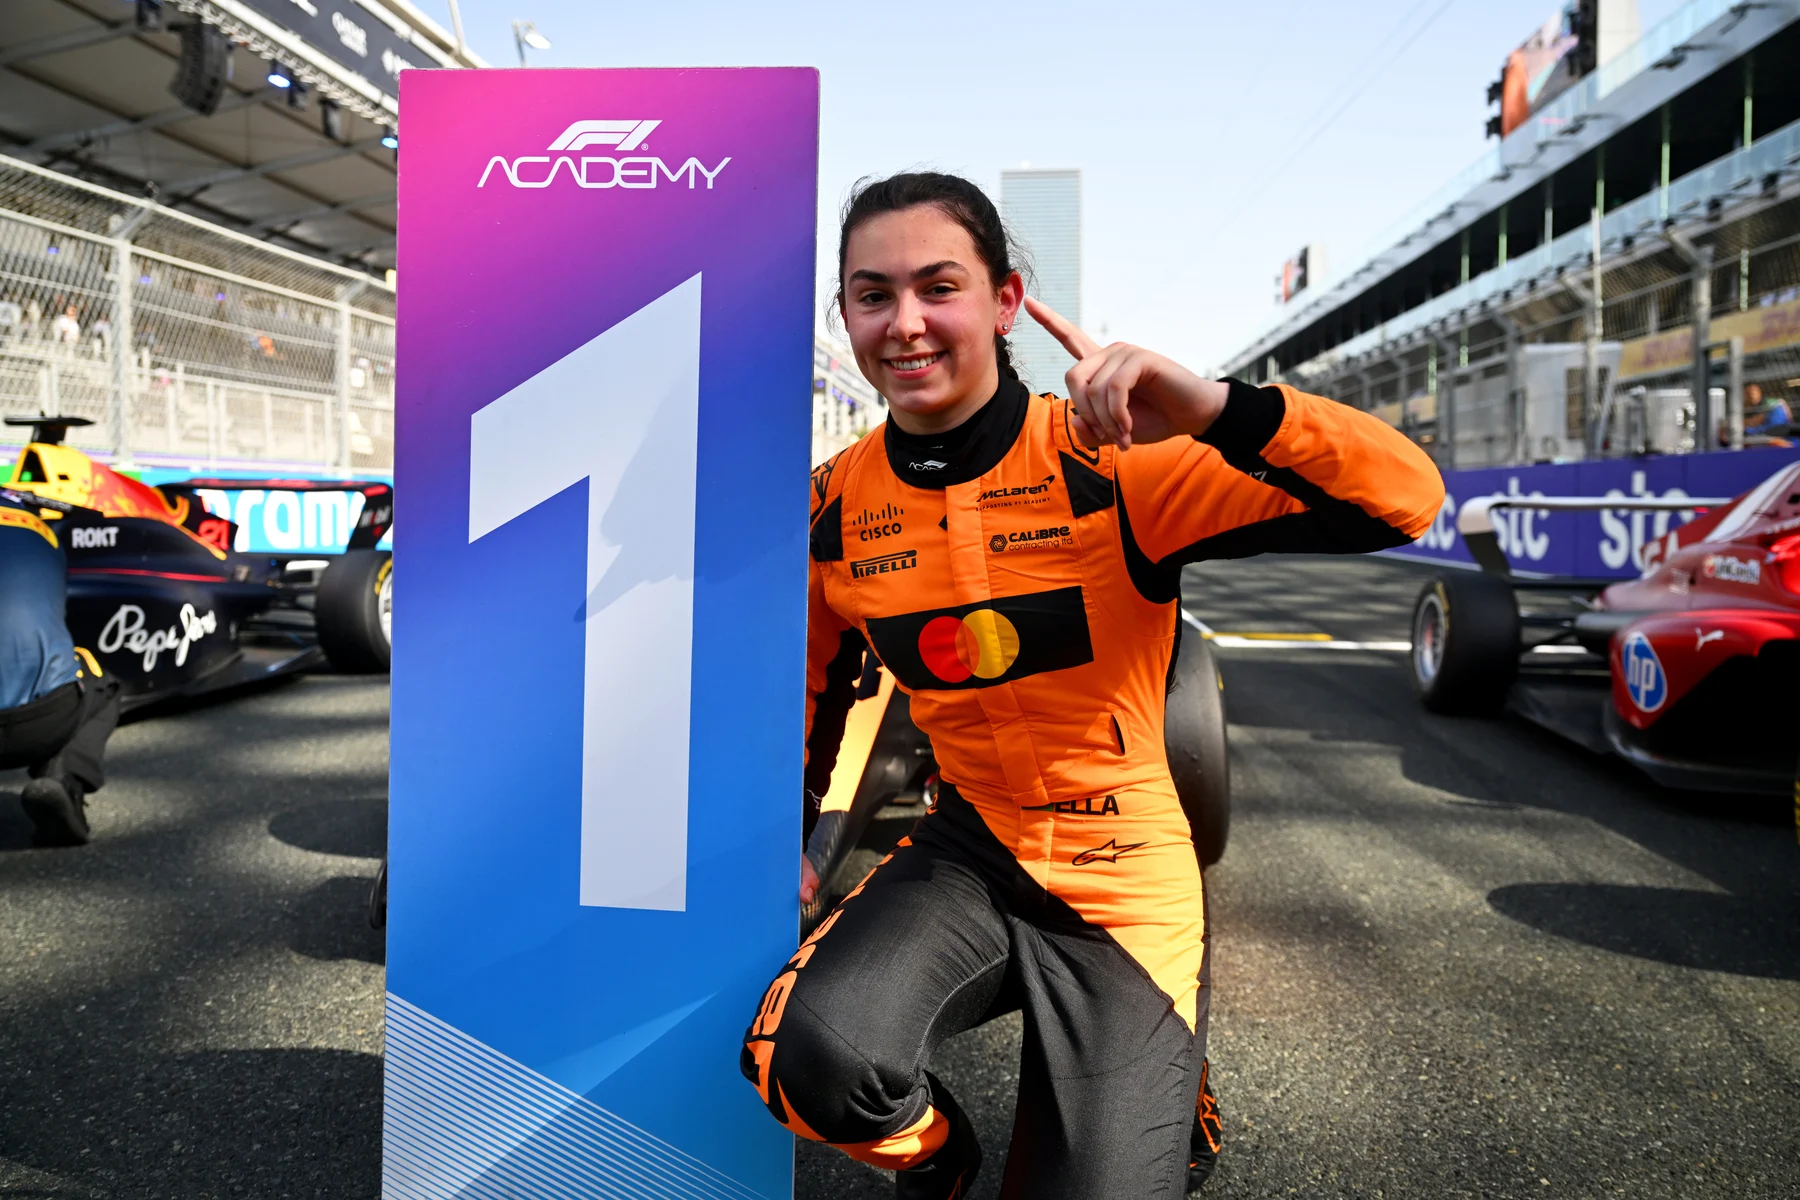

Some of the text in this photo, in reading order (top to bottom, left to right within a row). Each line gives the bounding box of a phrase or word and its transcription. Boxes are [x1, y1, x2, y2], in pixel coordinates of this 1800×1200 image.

[546, 120, 662, 150] F1
[476, 155, 732, 189] ACADEMY
[975, 501, 1013, 512] SUPPORTING
[1023, 496, 1051, 506] ACADEMY
[976, 483, 1049, 502] McLaren
[860, 522, 902, 542] CISCO
[1600, 470, 1697, 573] stc
[72, 527, 119, 548] ROKT
[1008, 536, 1074, 552] contracting ltd
[850, 549, 917, 579] PIRELLI
[469, 271, 702, 912] 1
[98, 604, 180, 673] Pepe
[1628, 641, 1656, 710] hp
[1054, 795, 1120, 816] ELLA
